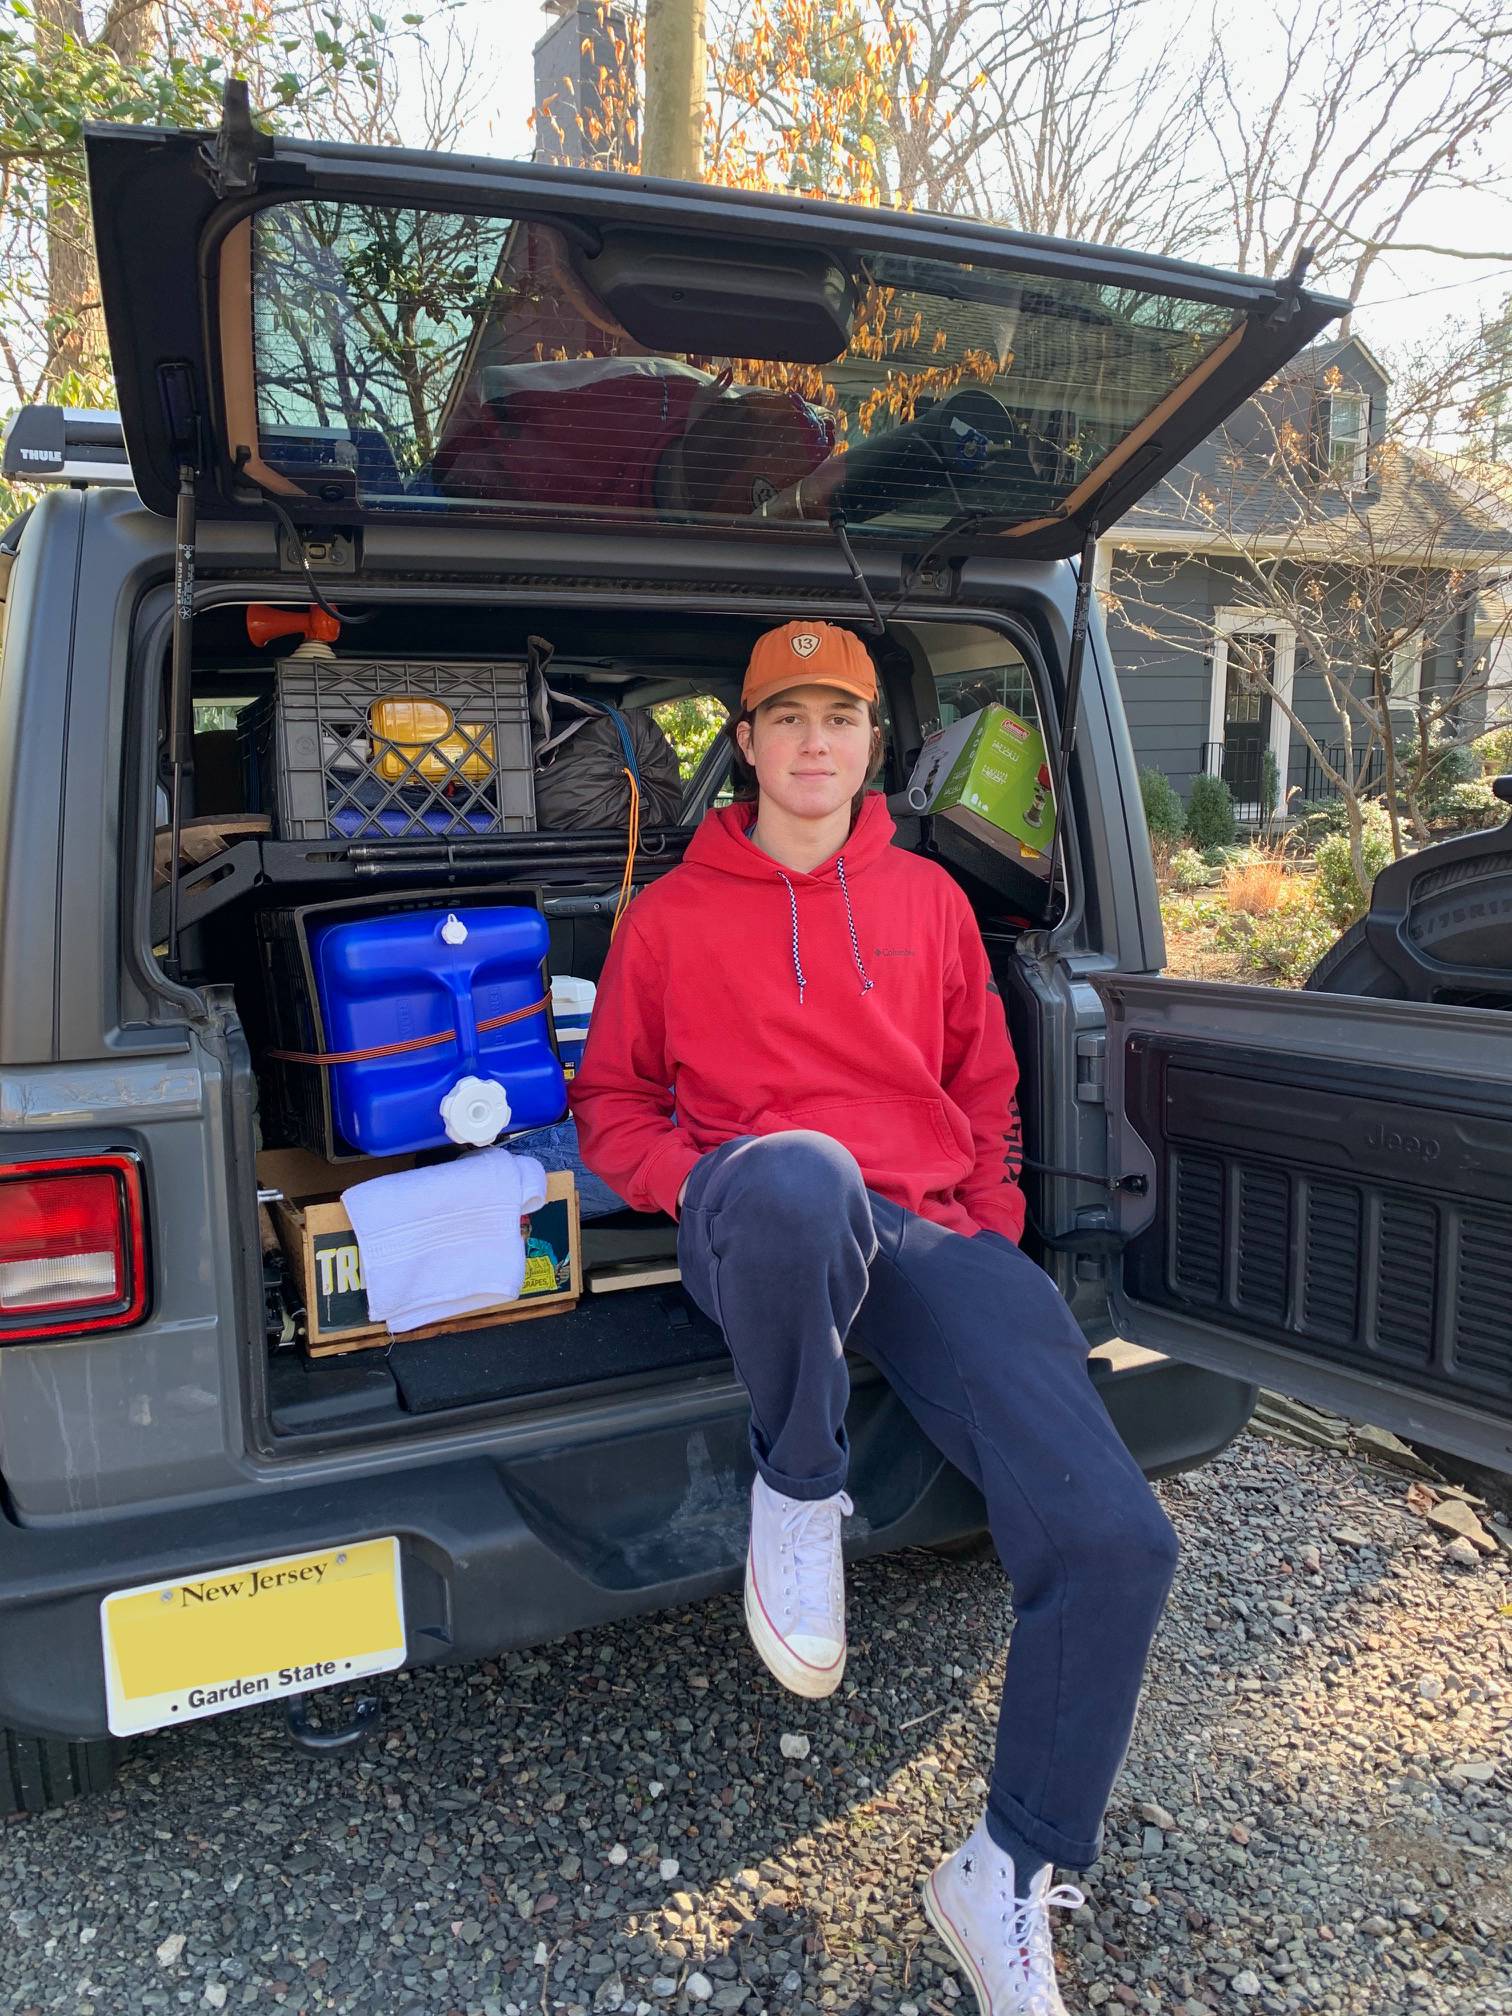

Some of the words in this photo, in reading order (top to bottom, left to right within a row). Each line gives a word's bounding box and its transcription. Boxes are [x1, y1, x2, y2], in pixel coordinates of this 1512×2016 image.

[20, 449, 62, 462] THULE
[797, 637, 813, 650] 13
[1367, 1122, 1440, 1163] Jeep
[181, 1581, 243, 1608] New
[248, 1562, 328, 1597] Jersey
[188, 1679, 269, 1709] Garden
[278, 1661, 336, 1686] State
